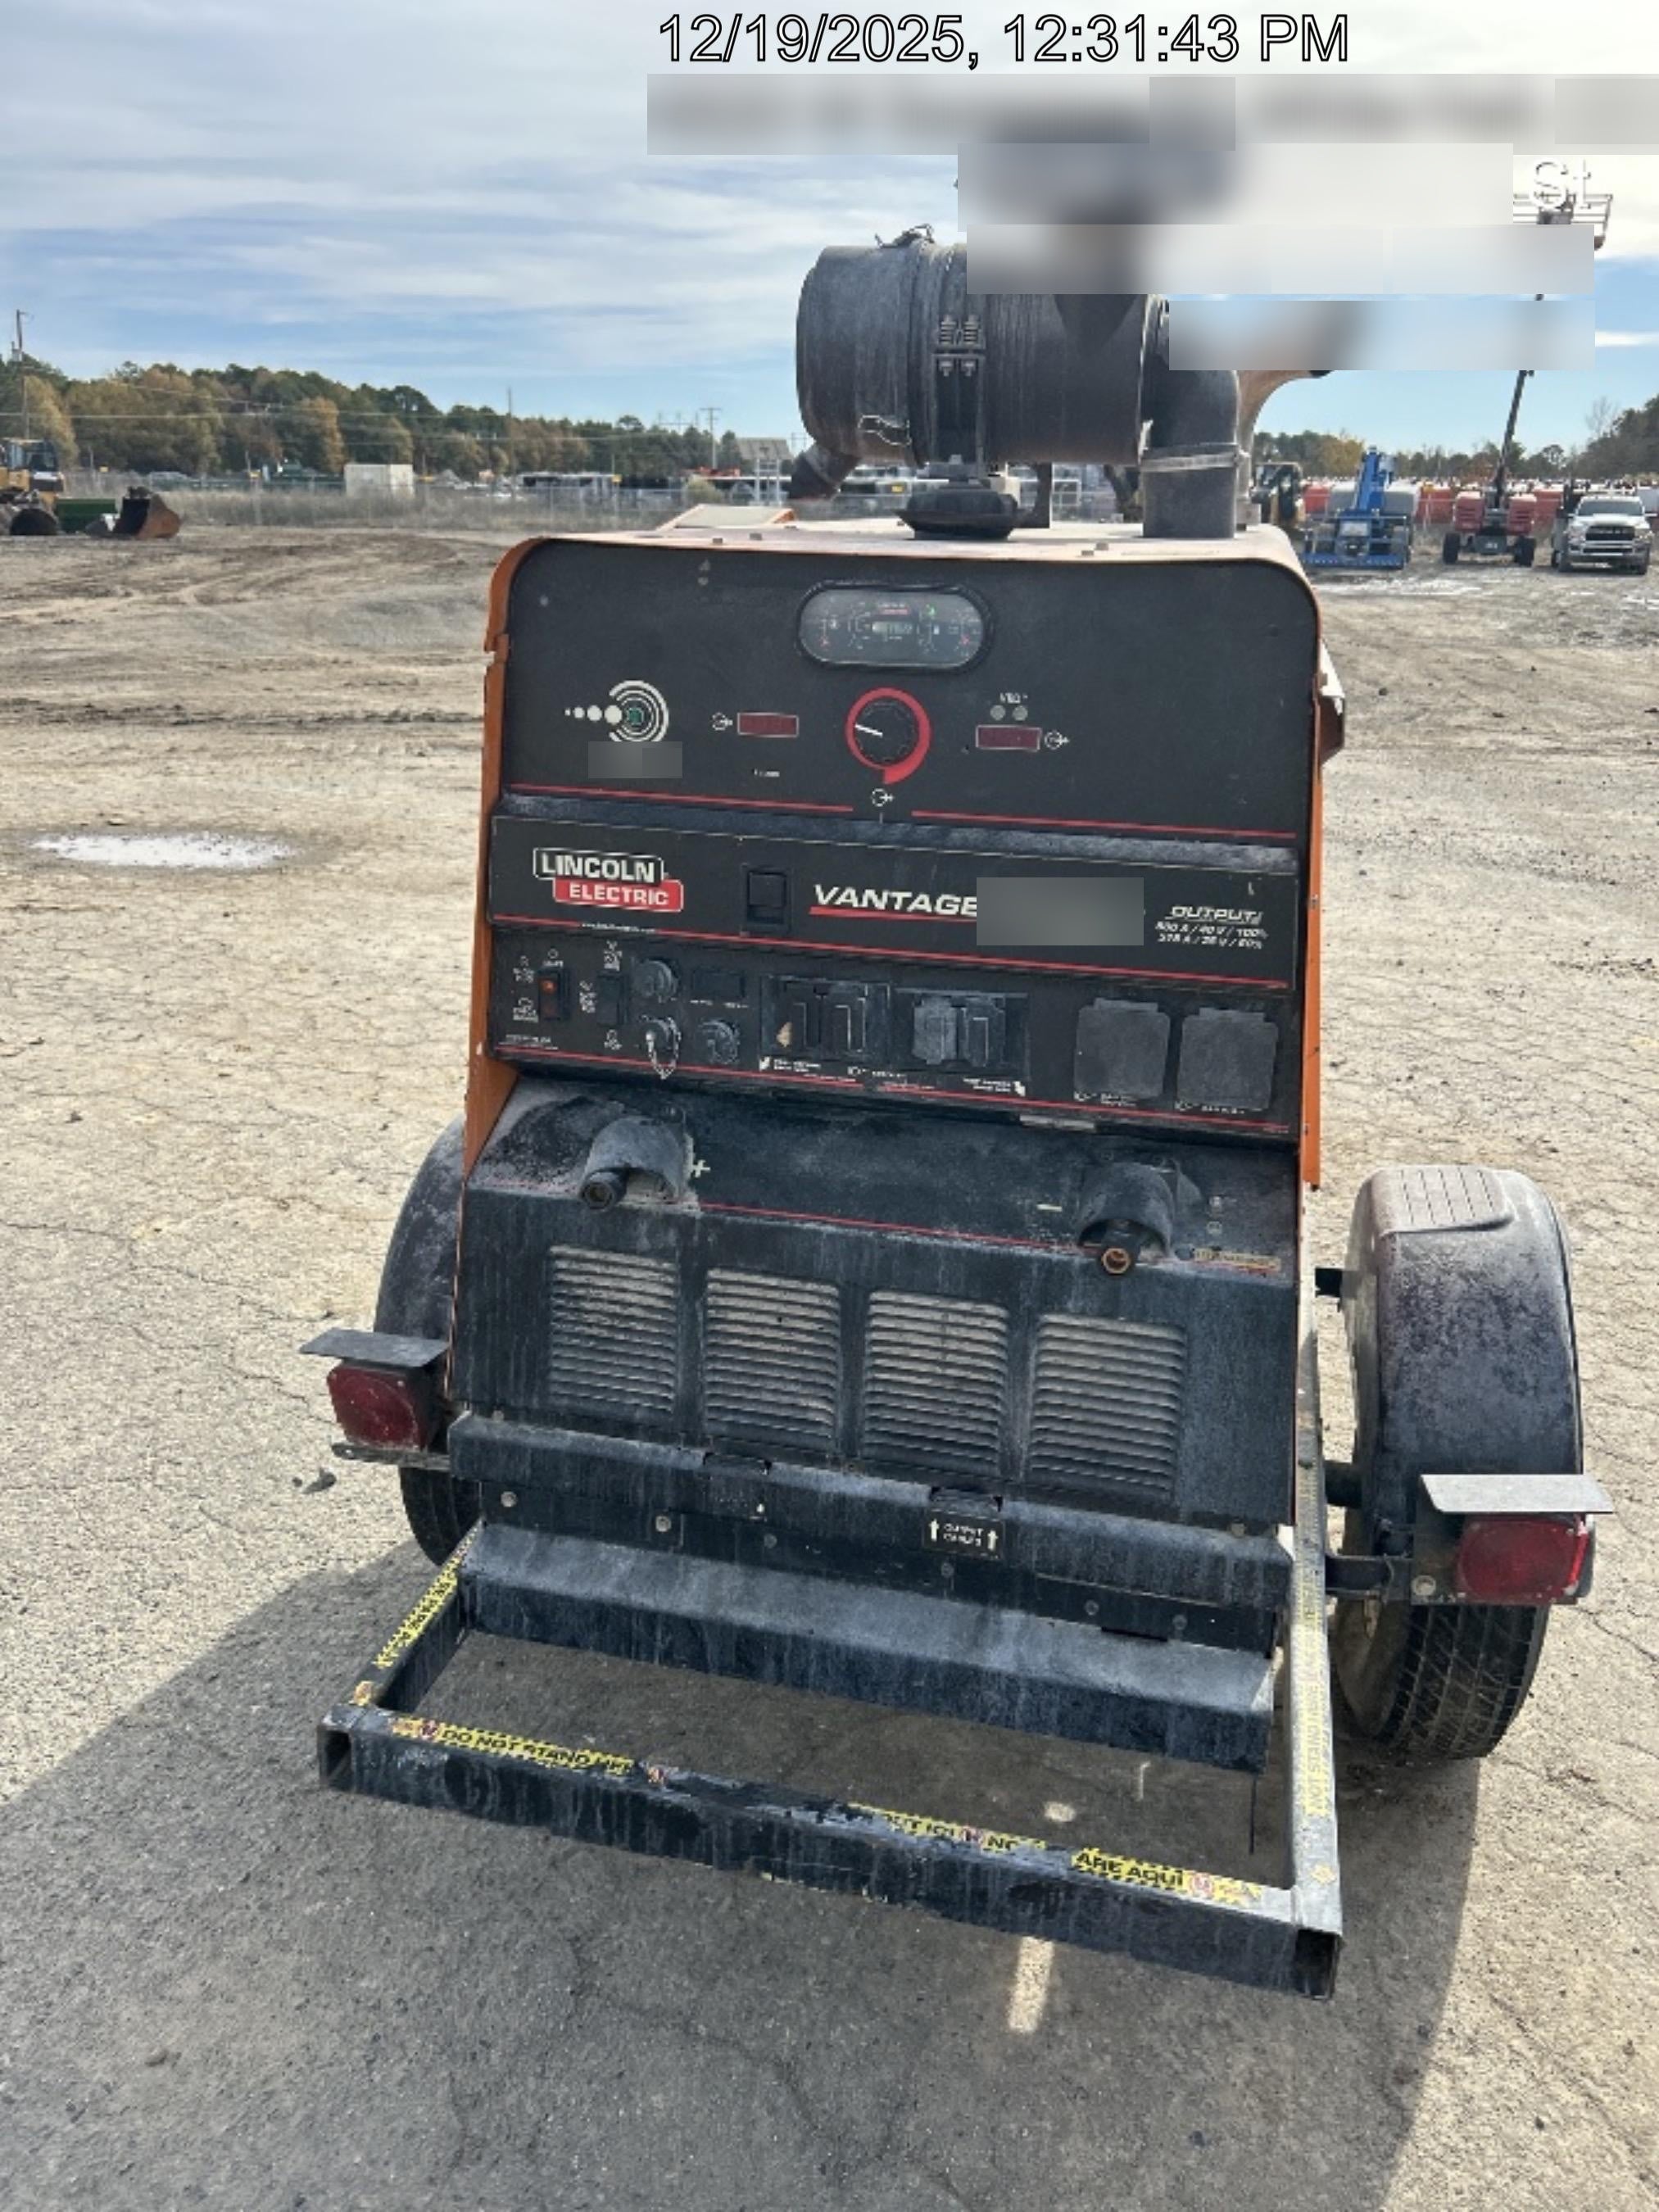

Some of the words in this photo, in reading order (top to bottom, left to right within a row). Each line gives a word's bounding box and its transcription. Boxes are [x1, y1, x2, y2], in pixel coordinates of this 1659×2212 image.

[541, 852, 655, 883] LINCOLN
[569, 882, 669, 906] ELECTRIC
[814, 883, 977, 918] VANTAGE
[1170, 906, 1258, 922] OUTPUT
